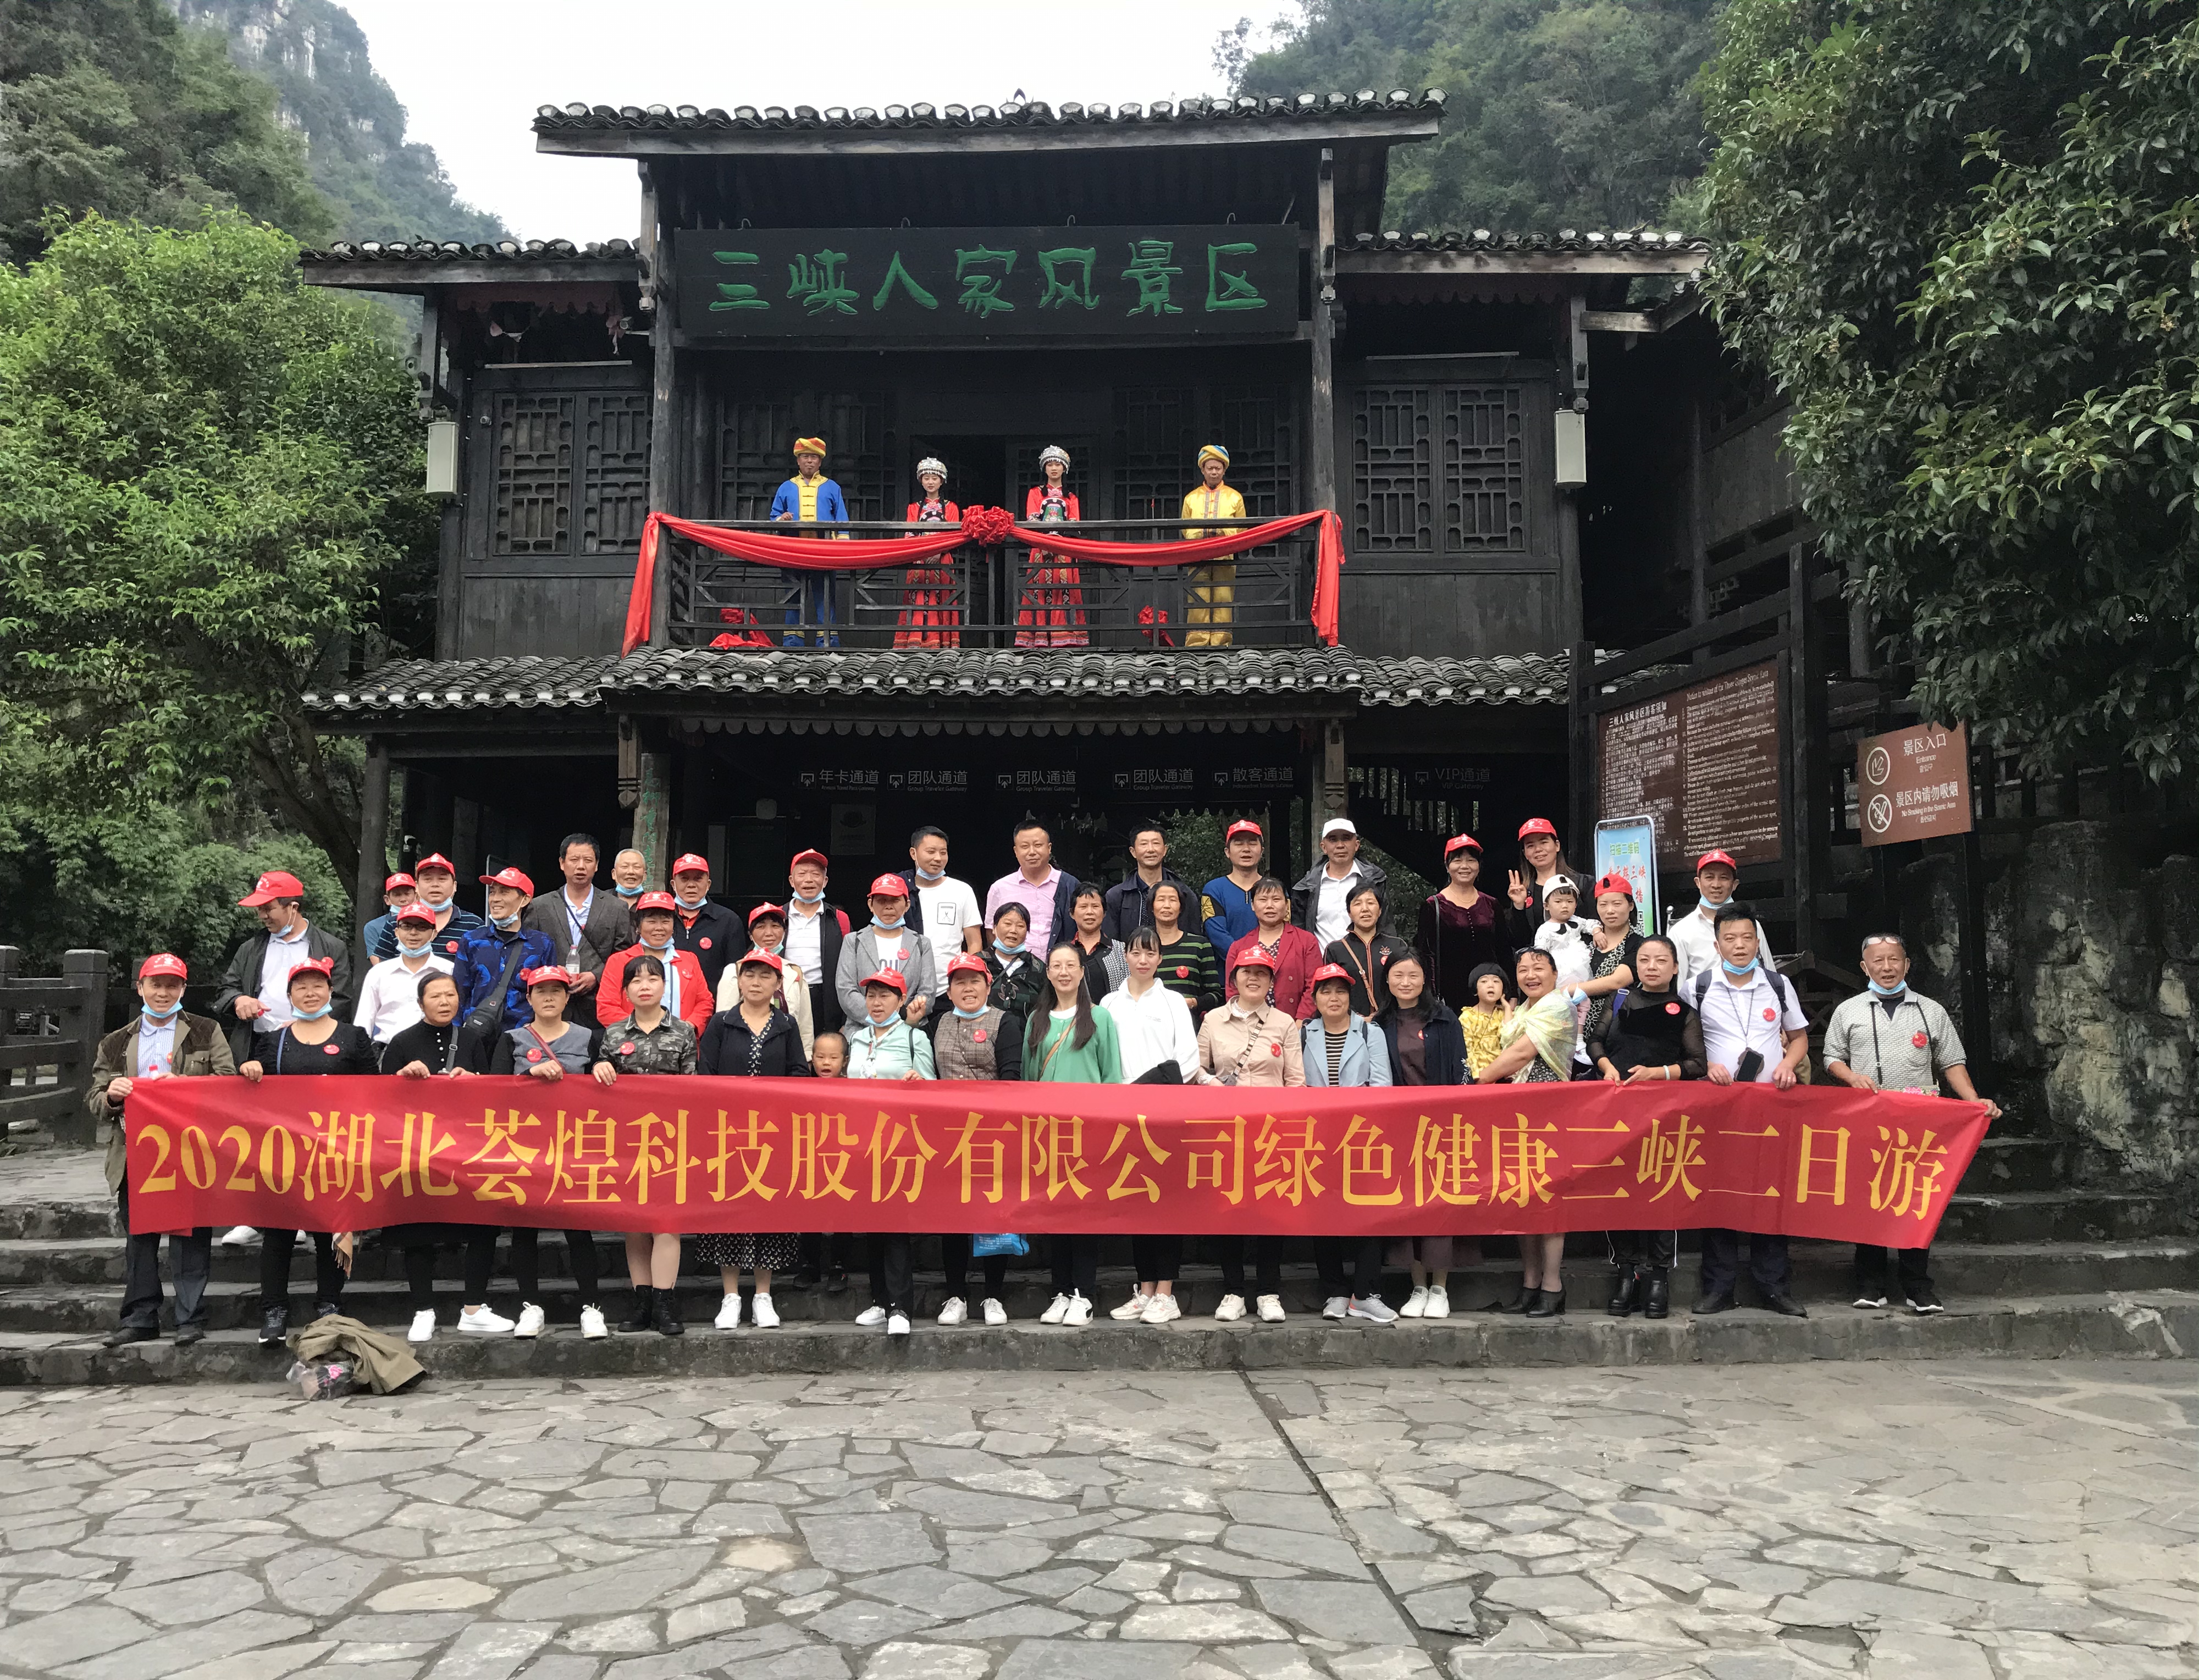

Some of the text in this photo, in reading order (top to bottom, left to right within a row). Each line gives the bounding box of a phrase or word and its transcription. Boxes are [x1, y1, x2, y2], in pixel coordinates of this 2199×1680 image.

[709, 240, 1268, 317] 三峡人家风景区
[1903, 733, 1947, 756] 景区入口
[1916, 754, 1937, 764] Entrance
[819, 769, 880, 784] 年卡通道
[908, 770, 968, 784] 团队通道
[1017, 770, 1076, 784] 团队通道
[1134, 768, 1194, 783] 团队通道
[1233, 766, 1294, 782] 散客通道
[1435, 768, 1491, 782] VIP通道
[1454, 782, 1484, 791] Gateway
[1896, 781, 1959, 808] 景区内请勿吸烟
[1933, 803, 1947, 811] Scenic
[1610, 842, 1639, 855] 扫描二维码
[136, 1108, 1947, 1221] 2020湖北荟煌科技股份有限公司绿色健康三峡二日游
